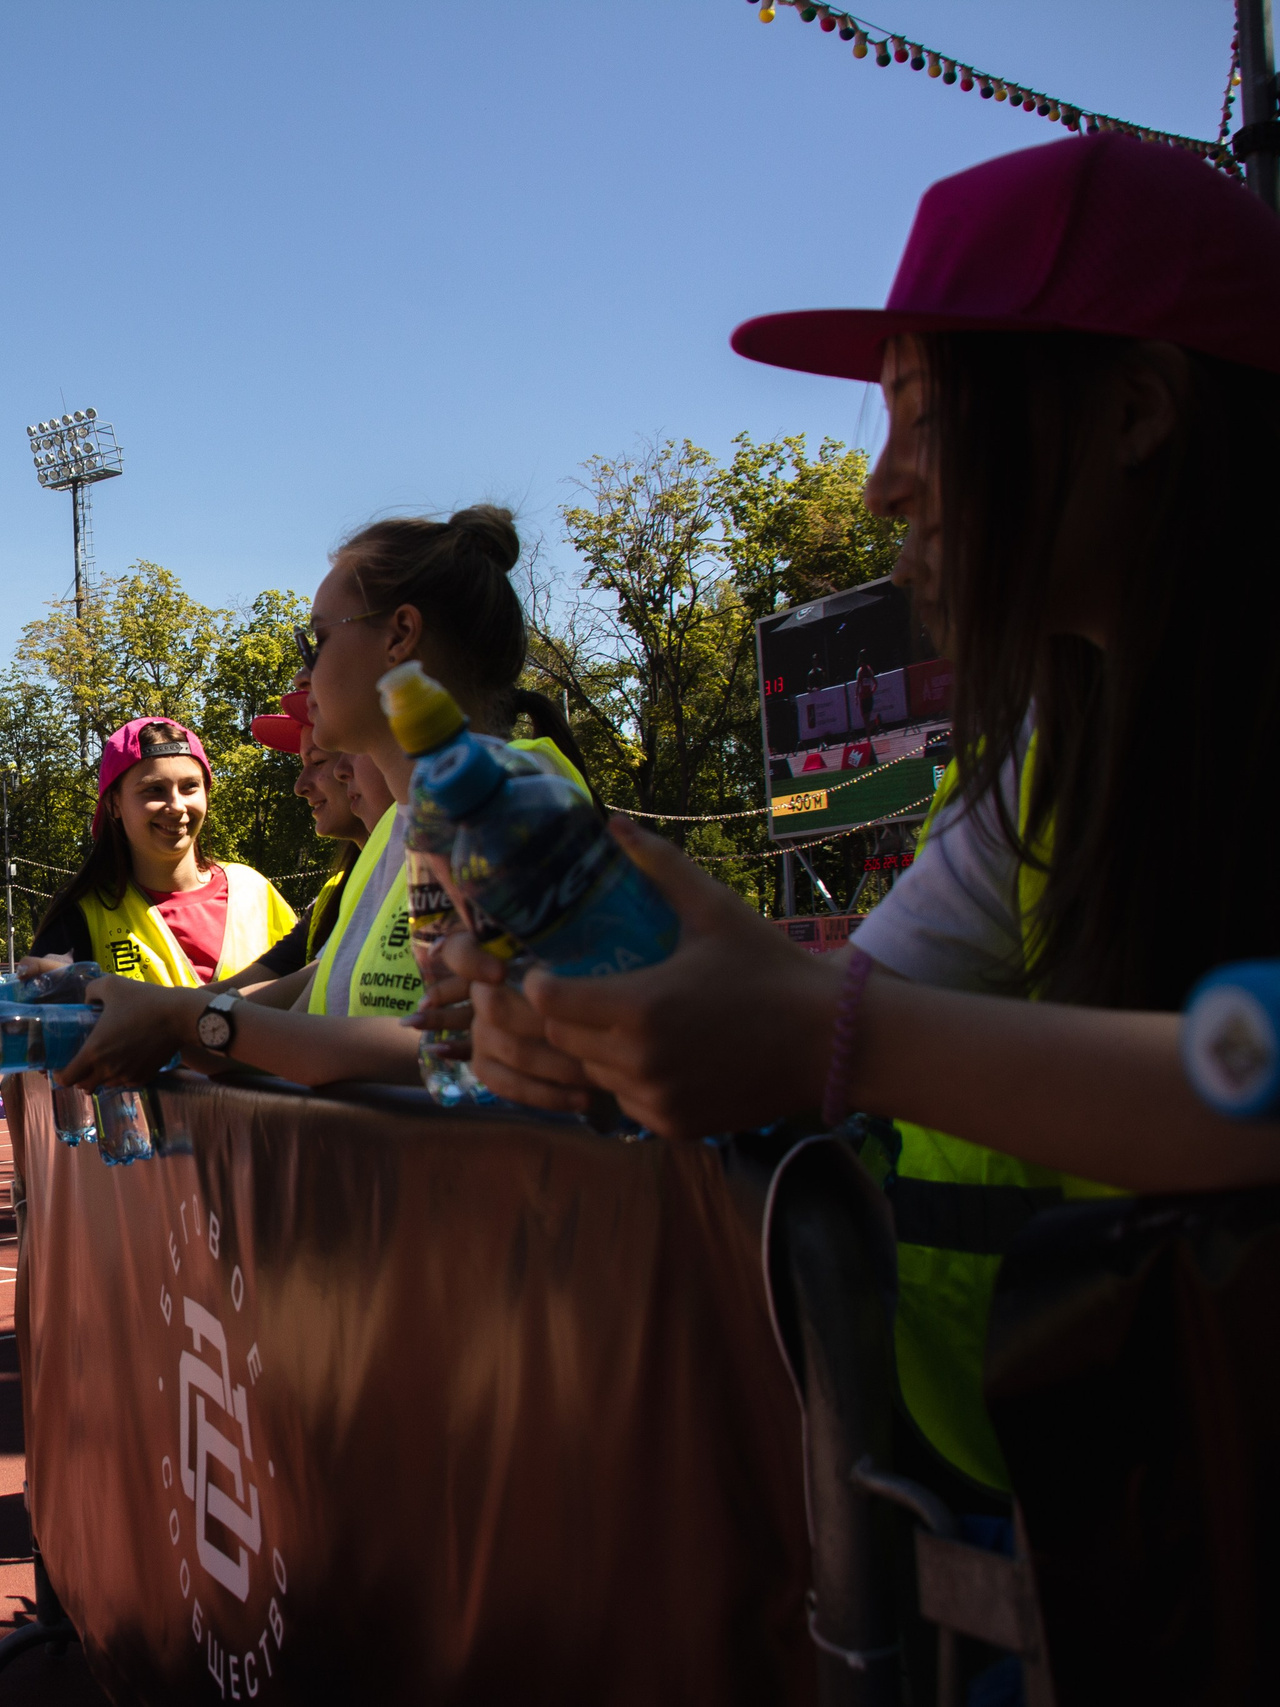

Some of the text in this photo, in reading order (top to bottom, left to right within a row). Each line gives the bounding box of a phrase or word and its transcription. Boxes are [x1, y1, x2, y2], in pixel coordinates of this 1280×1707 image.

[359, 991, 415, 1011] Volunteer
[160, 1193, 263, 1386] БЕГОВОЕ
[161, 1455, 287, 1700] СООБЩЕСТВО
